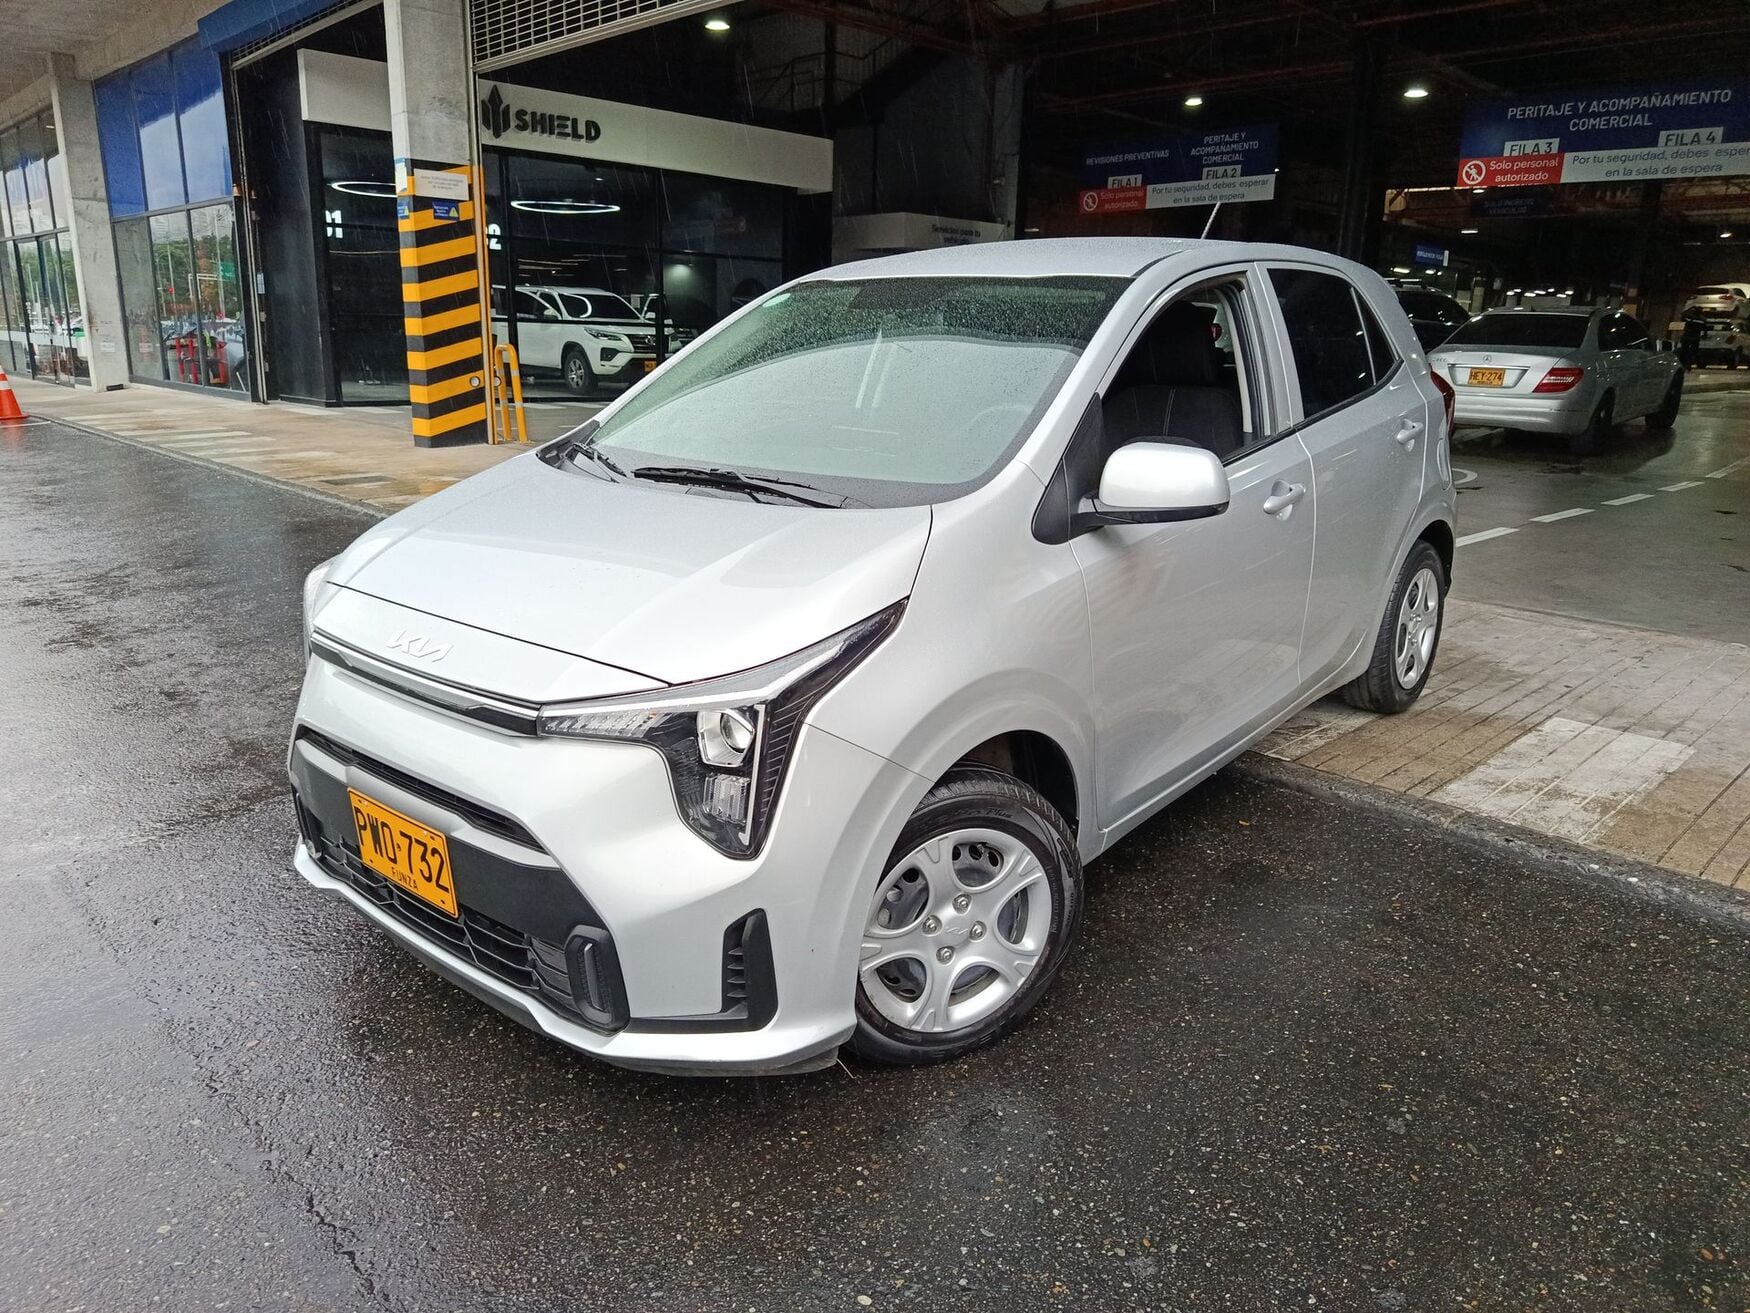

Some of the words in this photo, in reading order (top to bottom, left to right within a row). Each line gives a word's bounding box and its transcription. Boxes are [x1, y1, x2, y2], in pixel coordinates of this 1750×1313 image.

[1507, 102, 1575, 119] PERITAJE
[1577, 101, 1587, 113] Y
[1588, 89, 1732, 113] ACOMPAÑAMIENTO
[514, 108, 601, 142] SHIELD
[1569, 113, 1653, 131] COMERCIAL
[1203, 133, 1240, 145] PERITAJE
[1240, 132, 1247, 141] Y
[1665, 132, 1701, 147] FILA
[1705, 131, 1716, 145] 4
[1509, 143, 1541, 157] FILA
[1544, 142, 1553, 154] 3
[1572, 155, 1592, 165] Por
[1593, 155, 1604, 164] tu
[1606, 150, 1668, 165] seguridad,
[1671, 148, 1709, 160] debes
[1202, 153, 1245, 164] COMERCIAL
[1489, 161, 1512, 171] Solo
[1513, 157, 1559, 170] personal
[1206, 169, 1228, 180] FILA
[1230, 167, 1237, 178] 2
[1495, 171, 1549, 183] autorizado
[1605, 169, 1620, 178] en
[1622, 167, 1632, 177] la
[1635, 165, 1659, 176] sala
[1661, 164, 1678, 175] de
[1680, 163, 1723, 176] espera
[1112, 178, 1132, 188] FILA
[1213, 180, 1236, 190] debes
[1239, 178, 1269, 190] esperar
[1173, 196, 1183, 205] en
[1208, 193, 1219, 201] de
[1219, 192, 1245, 203] espera
[391, 866, 418, 891] FUNZA
